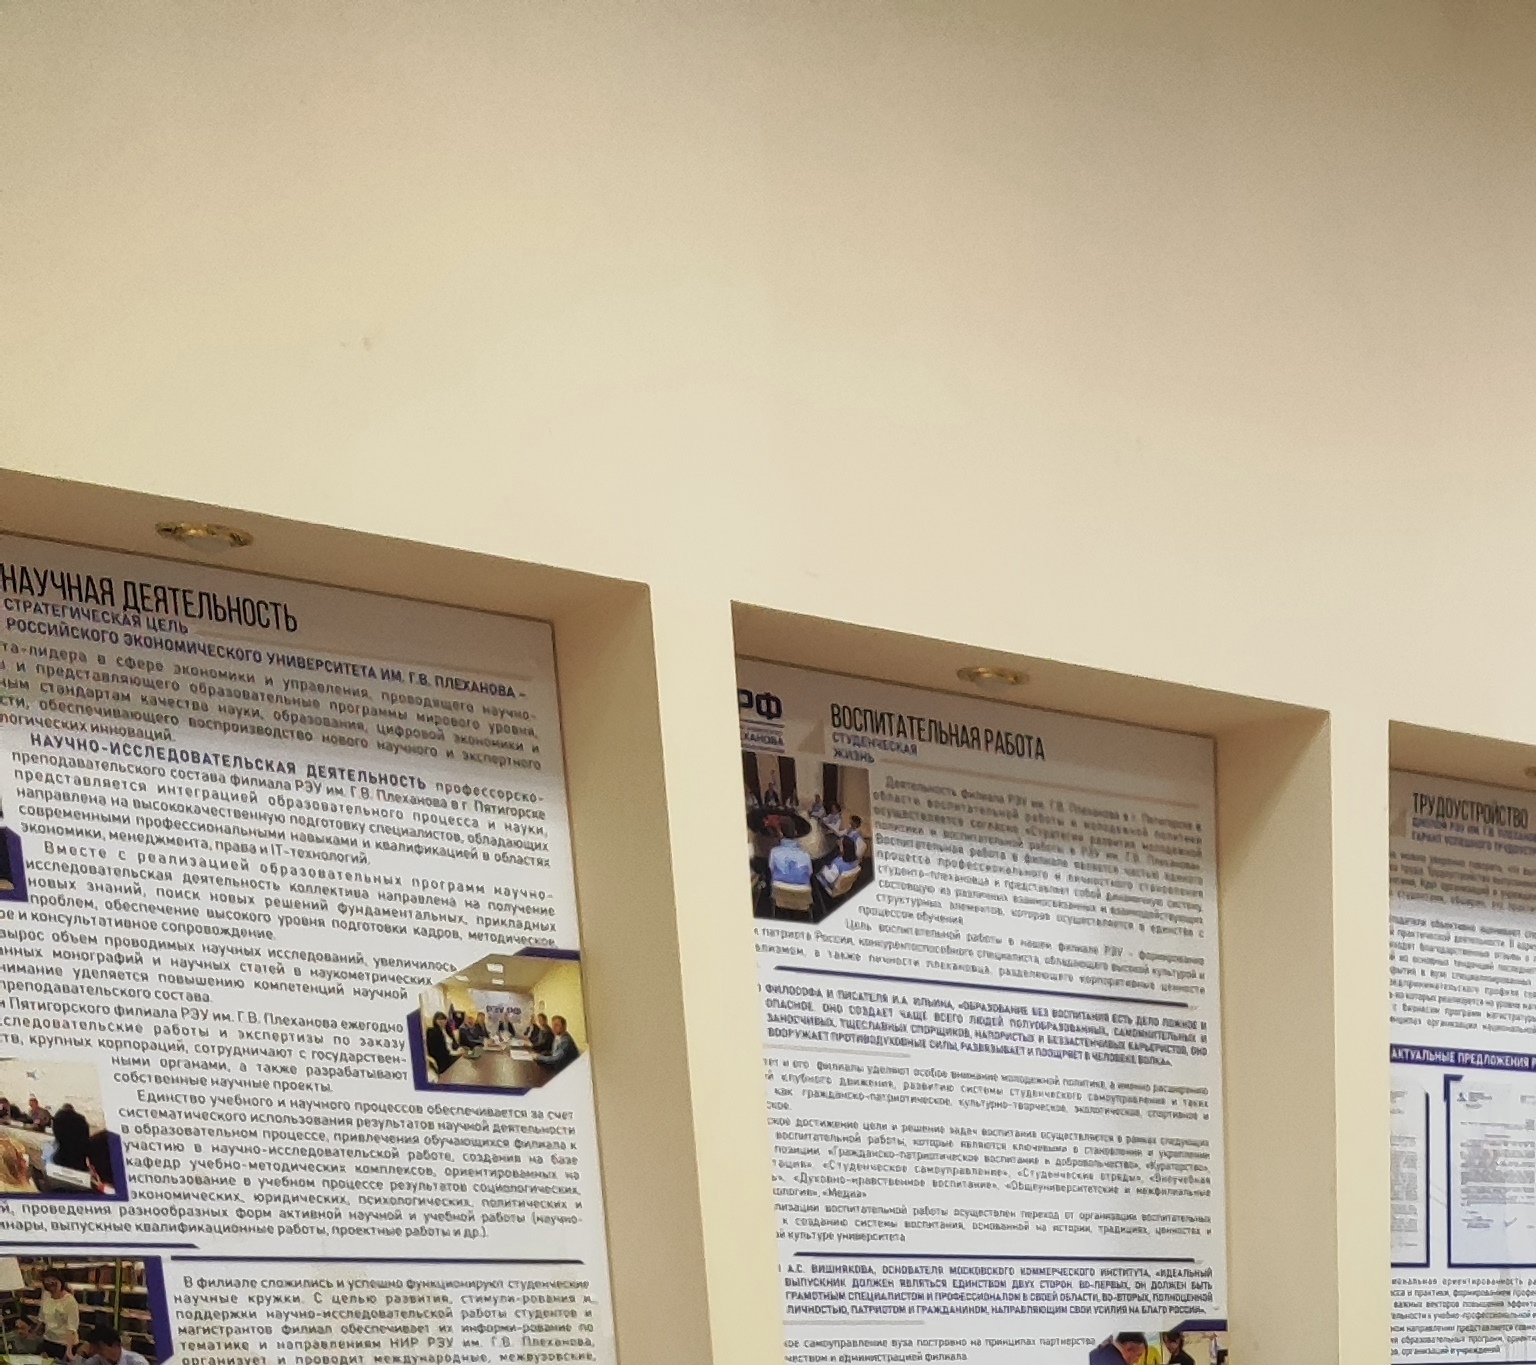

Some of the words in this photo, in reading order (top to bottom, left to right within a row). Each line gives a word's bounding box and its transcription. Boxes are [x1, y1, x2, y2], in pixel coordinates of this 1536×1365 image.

[0, 562, 115, 607] НАУЧНАЯ
[123, 580, 298, 633] ДЕЯТЕЛЬНОСТЬ
[2, 598, 142, 627] СТРАТЕГИЧЕСКАЯ
[145, 615, 188, 634] ЦЕЛЬ
[5, 617, 119, 643] РОССИЙСКОГО
[122, 633, 262, 662] ЭКОНОМИЧЕСКОГО
[265, 652, 377, 678] УНИВЕРСИТЕТА
[433, 675, 516, 697] ПЛЕХАНОВА
[830, 702, 981, 749] ВОСПИТАТЕЛЬНАЯ
[985, 728, 1046, 760] РАБОТА
[29, 734, 296, 773] НАУЧНО-ИССЛЕДОВАТЕЛЬСКАЯ
[306, 764, 426, 789] ДЕЯТЕЛЬНОСТЬ
[434, 782, 542, 802] профессорско-
[13, 769, 146, 791] представляется
[156, 785, 258, 803] интеграцией
[267, 794, 404, 819] образовательного
[412, 812, 480, 828] процесса
[486, 819, 496, 830] и
[1412, 792, 1528, 830] ТРУДОУСТРОЙСТВО
[1391, 1048, 1454, 1062] АКТУАЛЬНЫЕ
[1457, 1052, 1529, 1067] ПРЕДЛОЖЕНИЯ
